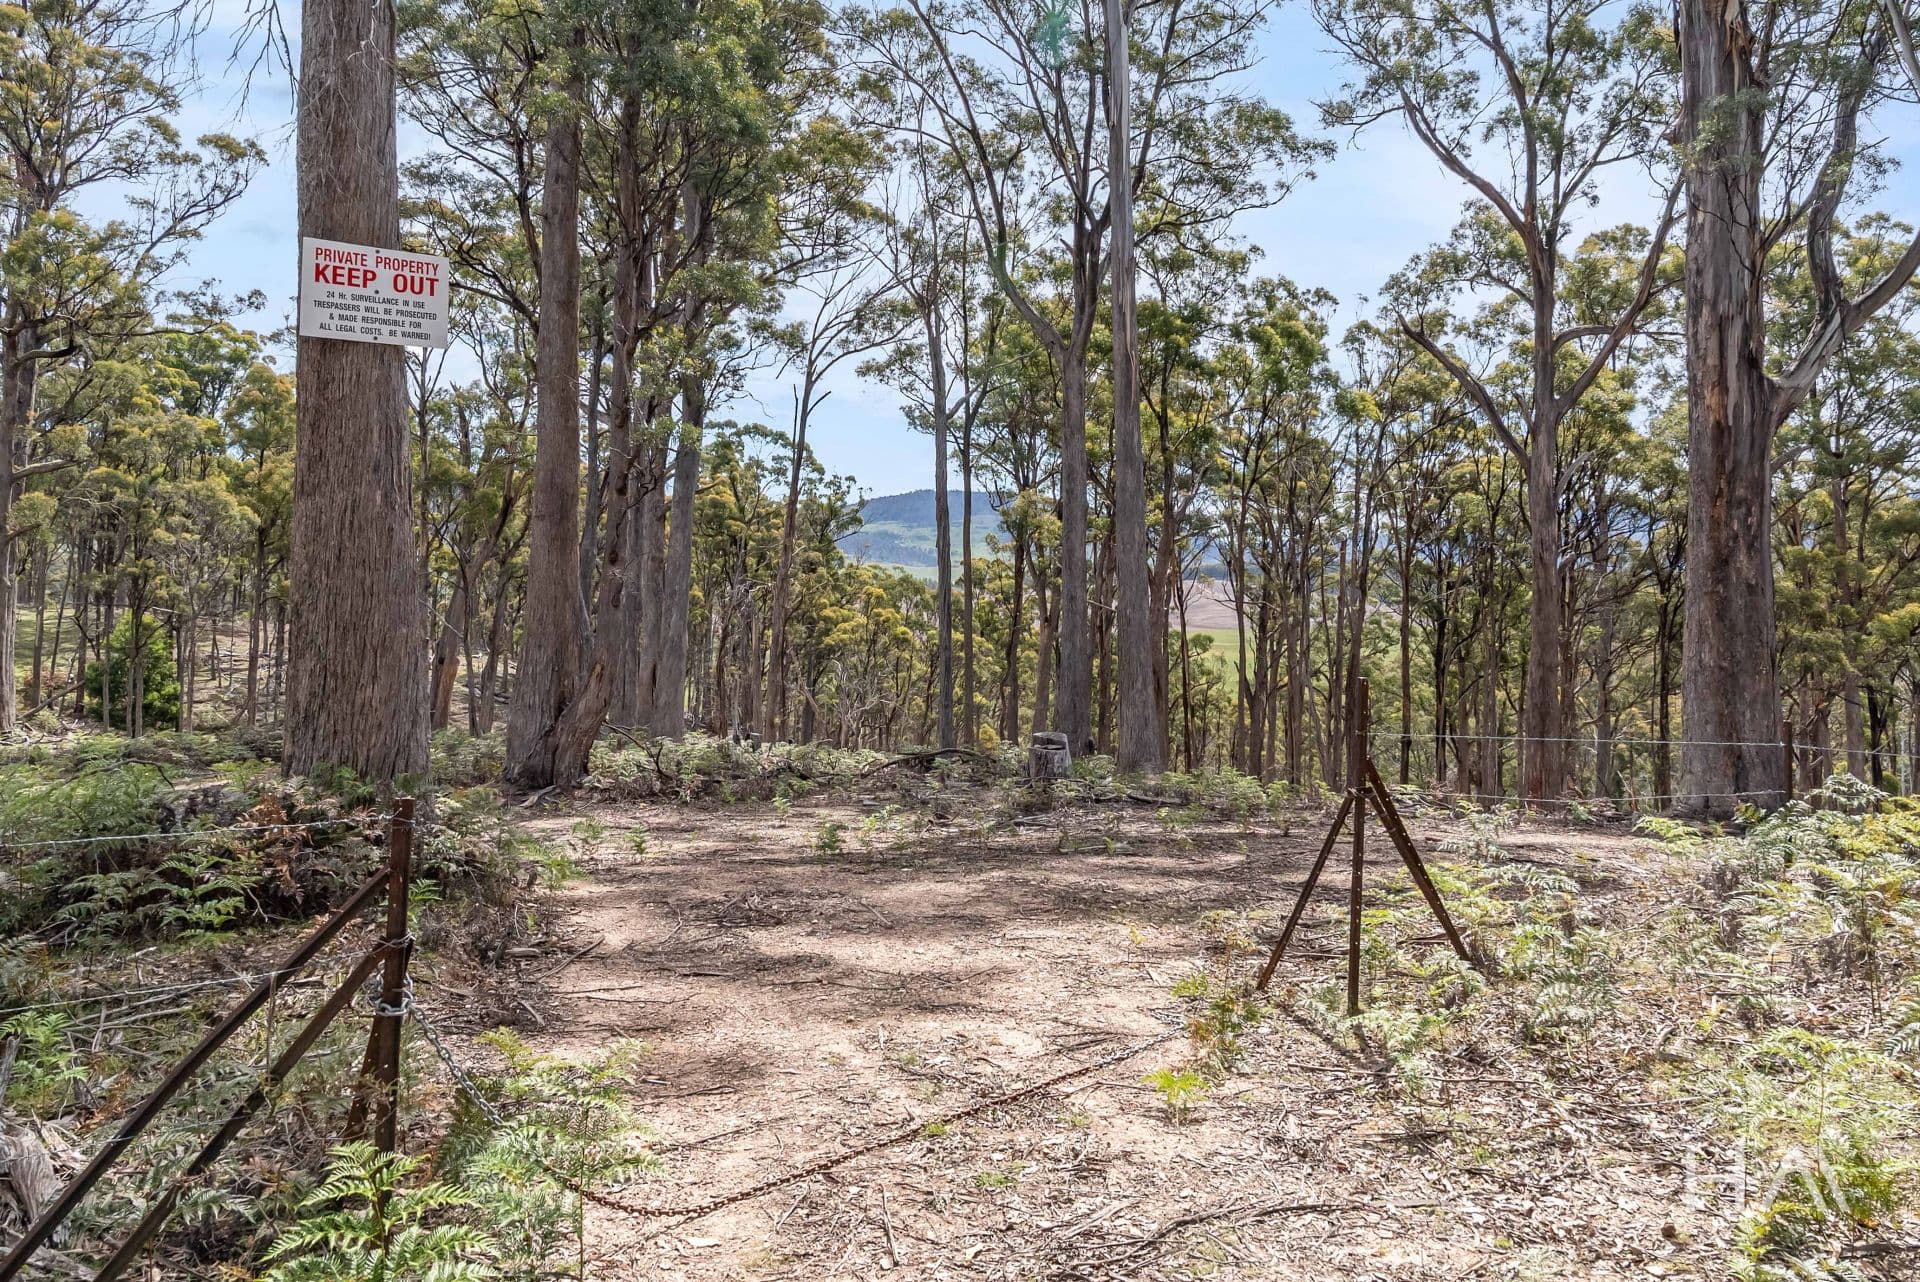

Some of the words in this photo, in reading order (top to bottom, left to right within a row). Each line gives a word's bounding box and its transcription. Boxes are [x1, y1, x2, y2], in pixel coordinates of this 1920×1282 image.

[315, 248, 367, 266] PRIVATE
[376, 256, 439, 275] PROPERTY
[314, 263, 377, 288] KEEP
[393, 274, 439, 296] OUT
[351, 294, 399, 306] SURVEILLANCE
[314, 300, 360, 312] TRESPASSERS
[396, 310, 437, 320] PROSECUTED
[338, 314, 358, 322] MADE
[362, 316, 405, 327] RESPONSIBLE
[336, 324, 356, 333] LEGAL
[360, 327, 383, 335] COSTS.
[401, 331, 430, 340] WARNED!
